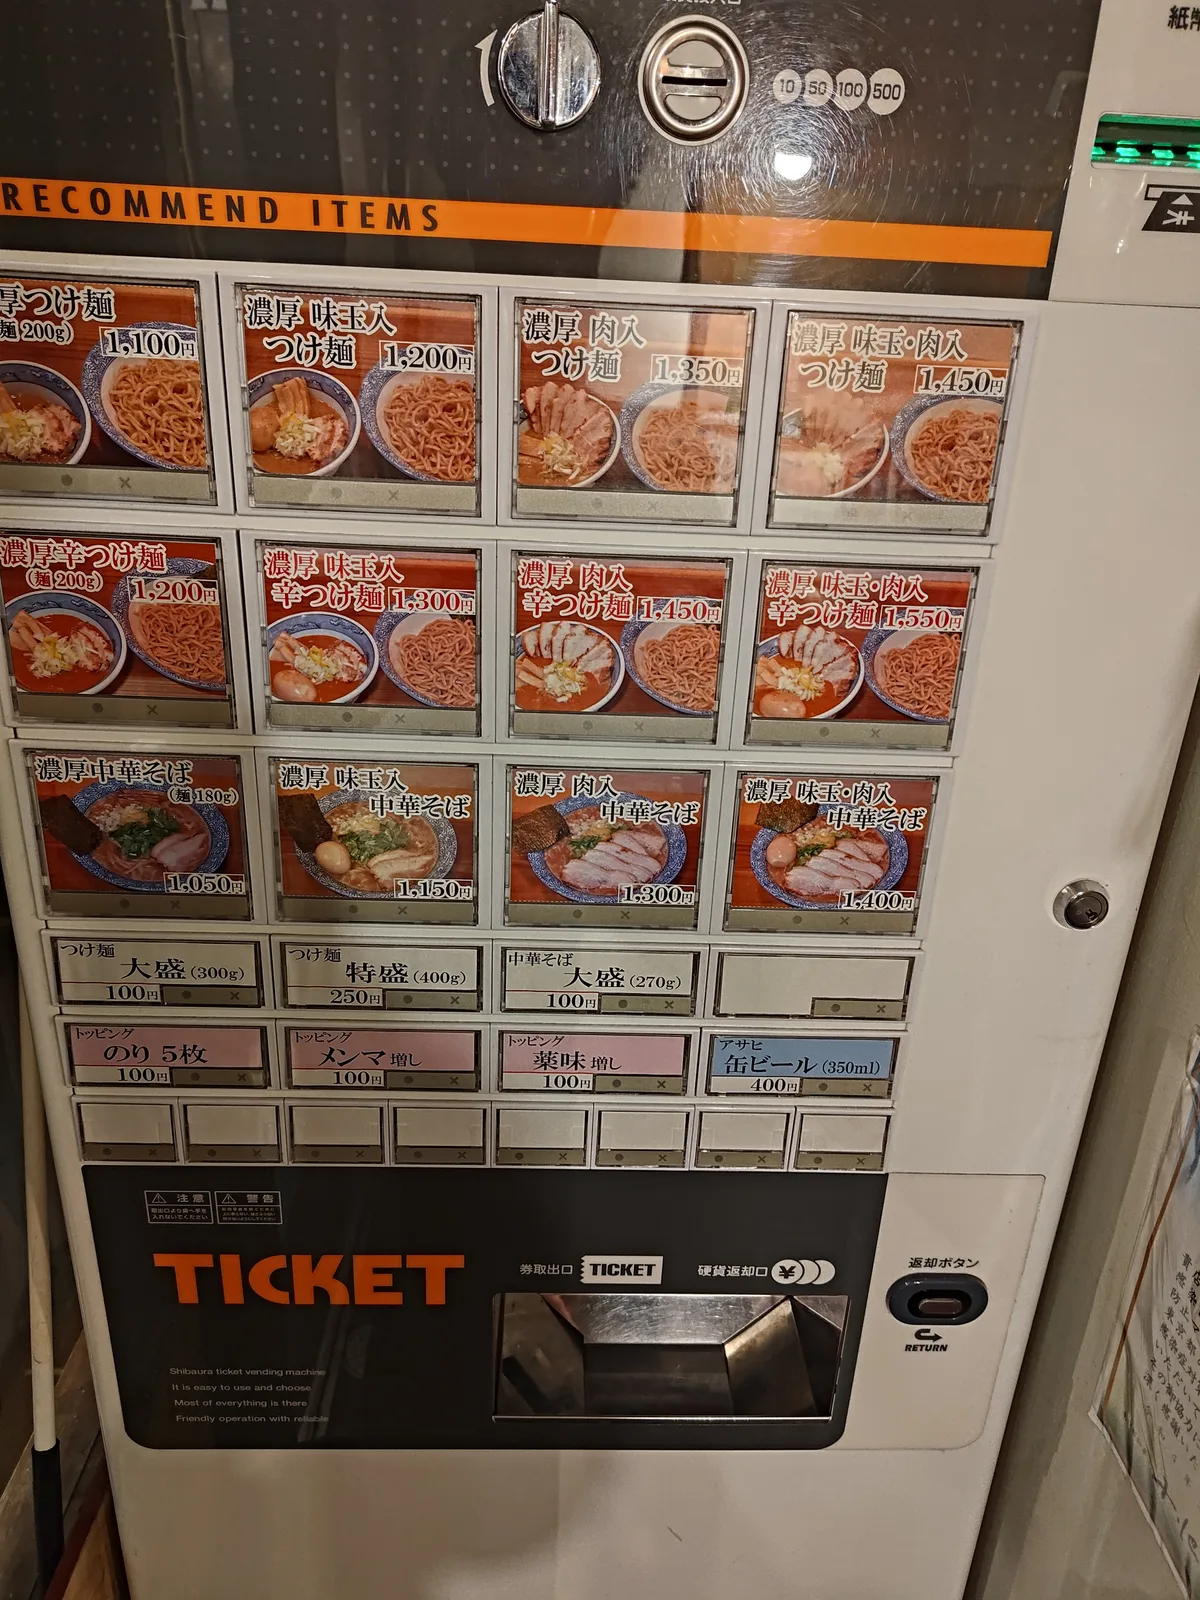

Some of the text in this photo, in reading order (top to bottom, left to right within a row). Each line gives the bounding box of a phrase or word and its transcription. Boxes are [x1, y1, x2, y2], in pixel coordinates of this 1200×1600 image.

[780, 79, 795, 94] 10
[808, 81, 827, 96] 50
[838, 82, 864, 98] 100
[872, 83, 902, 100] 500
[2, 182, 439, 232] RECOMMEND ITEMS
[0, 284, 114, 320] 厚つけ麺
[246, 297, 396, 335] 濃厚 味玉入
[523, 310, 647, 348] 濃厚 肉入
[105, 331, 196, 358] 1,100円
[792, 324, 848, 356] 濃厚
[265, 333, 357, 369] つけ麺
[384, 344, 473, 373] 1,200円
[533, 349, 621, 382] つけ麺
[654, 358, 743, 386] 1,350円
[800, 360, 887, 392] つけ麺
[919, 369, 1004, 395] 1,450円
[2, 540, 166, 572] 濃厚辛つけ麺
[265, 550, 403, 584] 濃厚 味玉入
[519, 561, 632, 592] 濃厚 肉入
[133, 580, 217, 603] 1,200円
[766, 571, 817, 598] 濃厚
[272, 580, 385, 612] 辛つけ麺
[393, 589, 474, 613] 1,300円
[524, 590, 632, 621] 辛つけ麺
[640, 599, 721, 623] 1,450円
[768, 600, 876, 629] 辛つけ麺
[883, 608, 963, 631] 1,550円
[35, 758, 192, 785] 濃厚中華そば
[281, 765, 407, 793] 濃厚 味玉入
[515, 773, 619, 797] 濃厚 肉入
[745, 780, 791, 803] 濃厚
[369, 795, 470, 818] 中華そば
[601, 802, 698, 825] 中華そば
[827, 808, 925, 831] 中華そば
[168, 874, 244, 894] 1,050円
[397, 880, 472, 900] 1,150円
[622, 885, 694, 905] 1,300円
[842, 891, 914, 910] 1,400円
[60, 942, 116, 958] つけ麺
[288, 947, 342, 963] つけ麺
[507, 952, 574, 968] 中華そば
[106, 984, 159, 1002] 100円
[329, 988, 381, 1006] 250円
[547, 993, 597, 1010] 100円
[75, 1026, 135, 1040] トッピング
[294, 1030, 353, 1044] トッピング
[507, 1034, 564, 1048] トッピング
[103, 1044, 150, 1064] のり
[719, 1038, 763, 1052] アサヒ
[117, 1067, 168, 1083] 100円
[333, 1070, 382, 1086] 100円
[542, 1074, 592, 1090] 100円
[750, 1077, 798, 1094] 400円
[519, 1263, 574, 1275] 券取出口
[589, 1263, 657, 1276] TICKET
[697, 1265, 769, 1277] 硬貨返却口
[908, 1257, 980, 1269] 返却ボタン
[153, 1253, 465, 1306] TICKET
[904, 1344, 949, 1352] RETURN
[169, 1367, 326, 1377] Shibaura ticket vending machine
[193, 1385, 217, 1393] easy
[220, 1384, 231, 1392] to
[254, 1384, 273, 1392] and
[275, 1384, 312, 1392] choose
[174, 1399, 200, 1407] Most
[202, 1399, 212, 1407] of
[215, 1399, 268, 1409] everything
[281, 1399, 308, 1407] there
[176, 1415, 216, 1424] Friendly
[218, 1415, 266, 1424] operation
